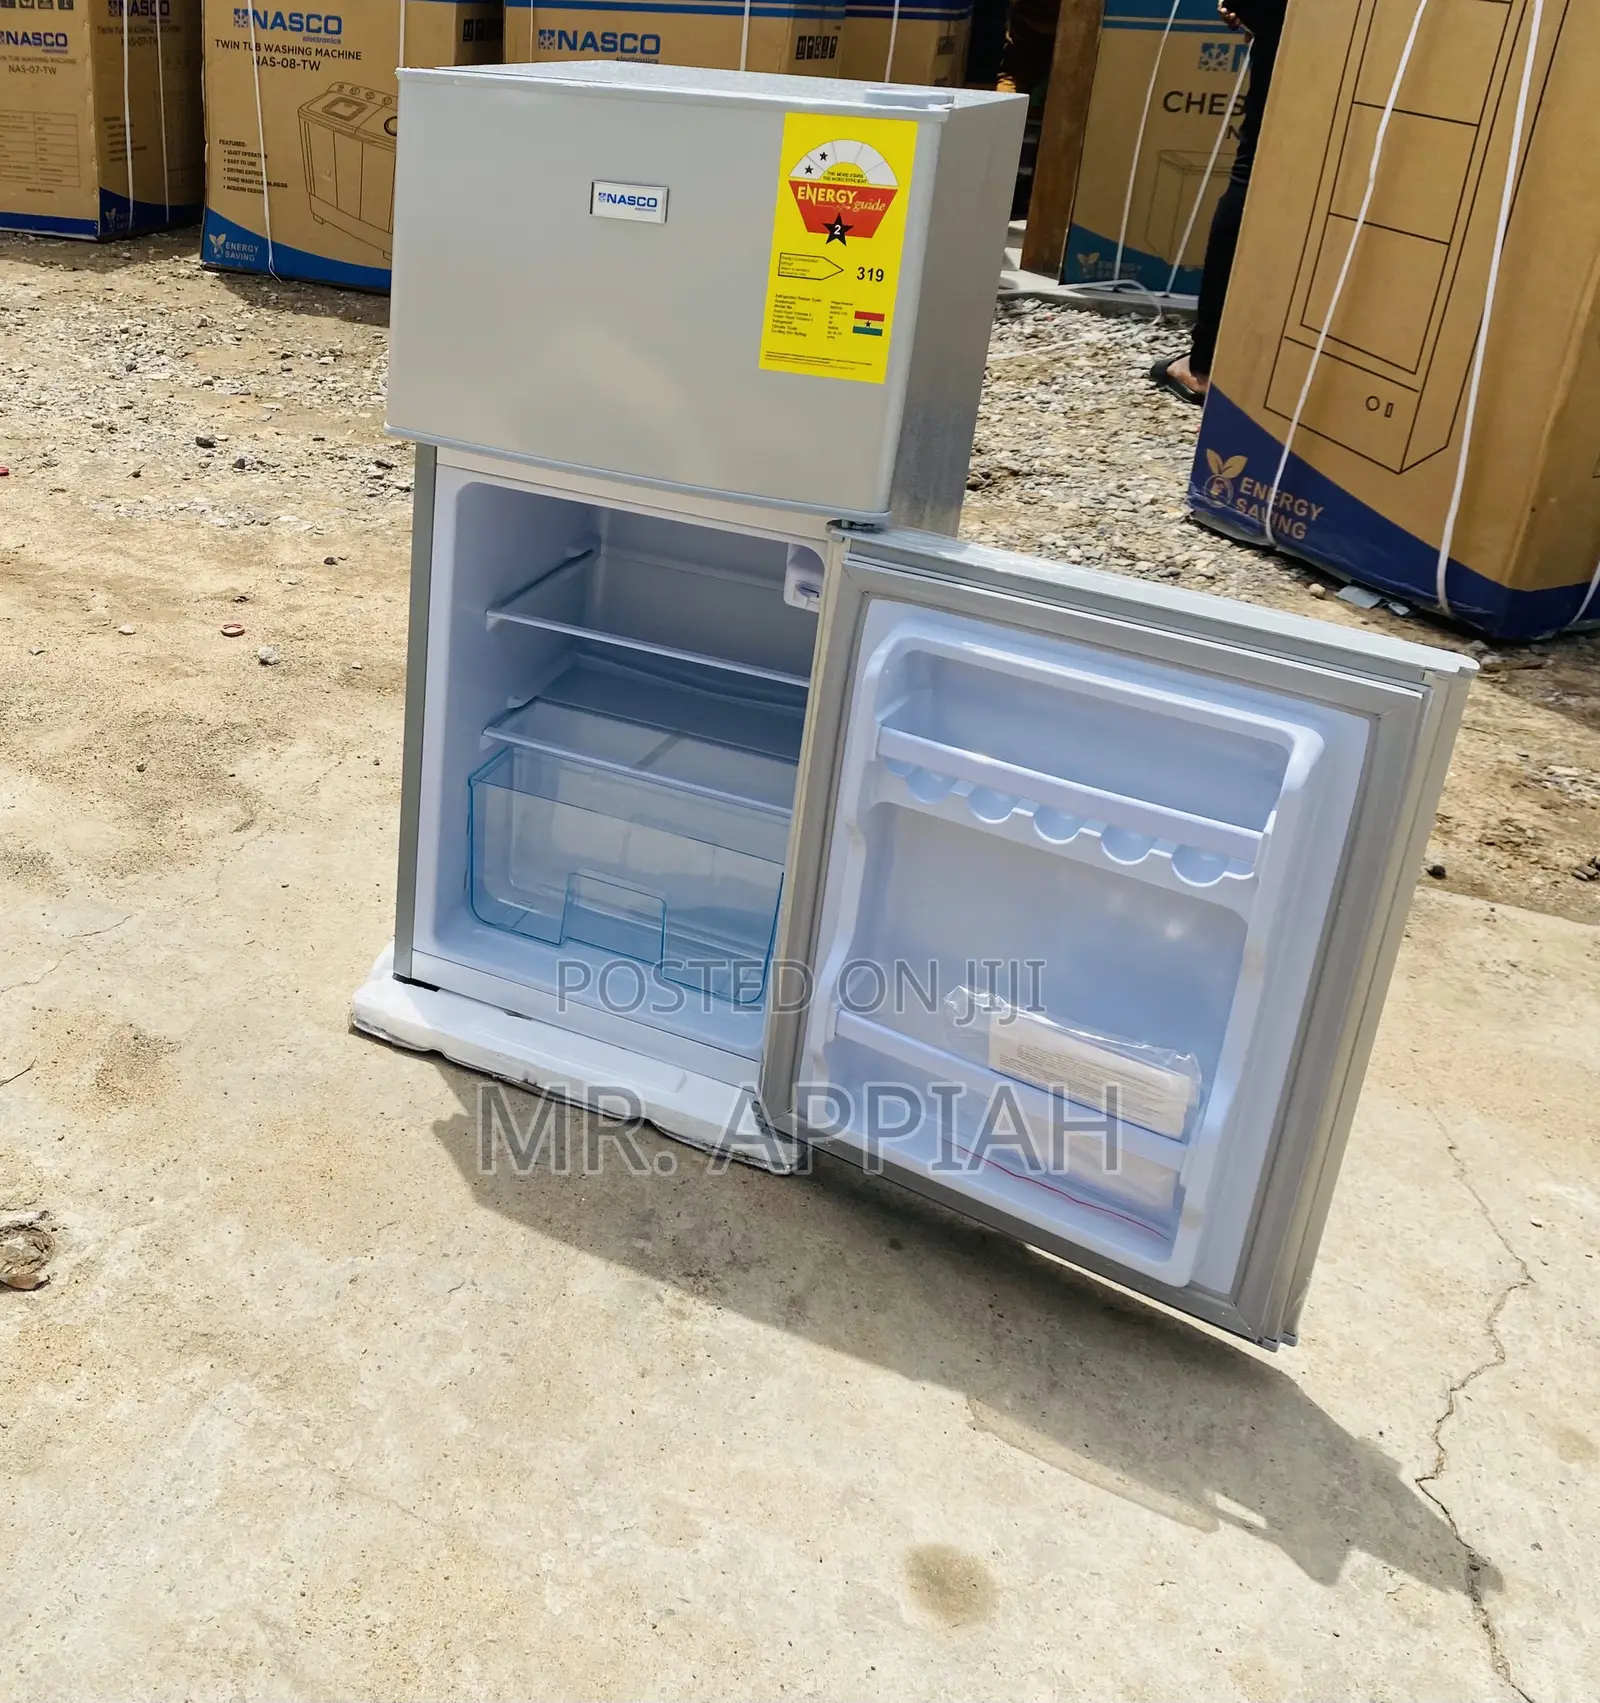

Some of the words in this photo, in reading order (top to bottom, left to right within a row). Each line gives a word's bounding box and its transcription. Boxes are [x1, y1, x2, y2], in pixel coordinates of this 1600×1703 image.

[251, 9, 342, 35] NASCO
[6, 31, 68, 47] NASCO
[302, 35, 342, 45] electronics
[557, 30, 661, 55] NASCO
[215, 39, 240, 50] TWIN
[243, 41, 261, 51] TUB
[264, 43, 312, 56] WASHING
[315, 48, 362, 60] MACHINE
[8, 64, 57, 75] NAS-07-TW
[253, 55, 321, 71] NAS-08-TW
[1163, 90, 1246, 116] CHES
[242, 151, 268, 159] OPERATIN
[606, 193, 658, 208] NASCO
[797, 183, 858, 206] ENERGY
[852, 198, 887, 212] guide
[833, 224, 842, 235] 2
[225, 241, 259, 253] ENERGY
[225, 250, 255, 262] SAVING
[856, 266, 885, 283] 319
[1239, 476, 1325, 521] ENERGY
